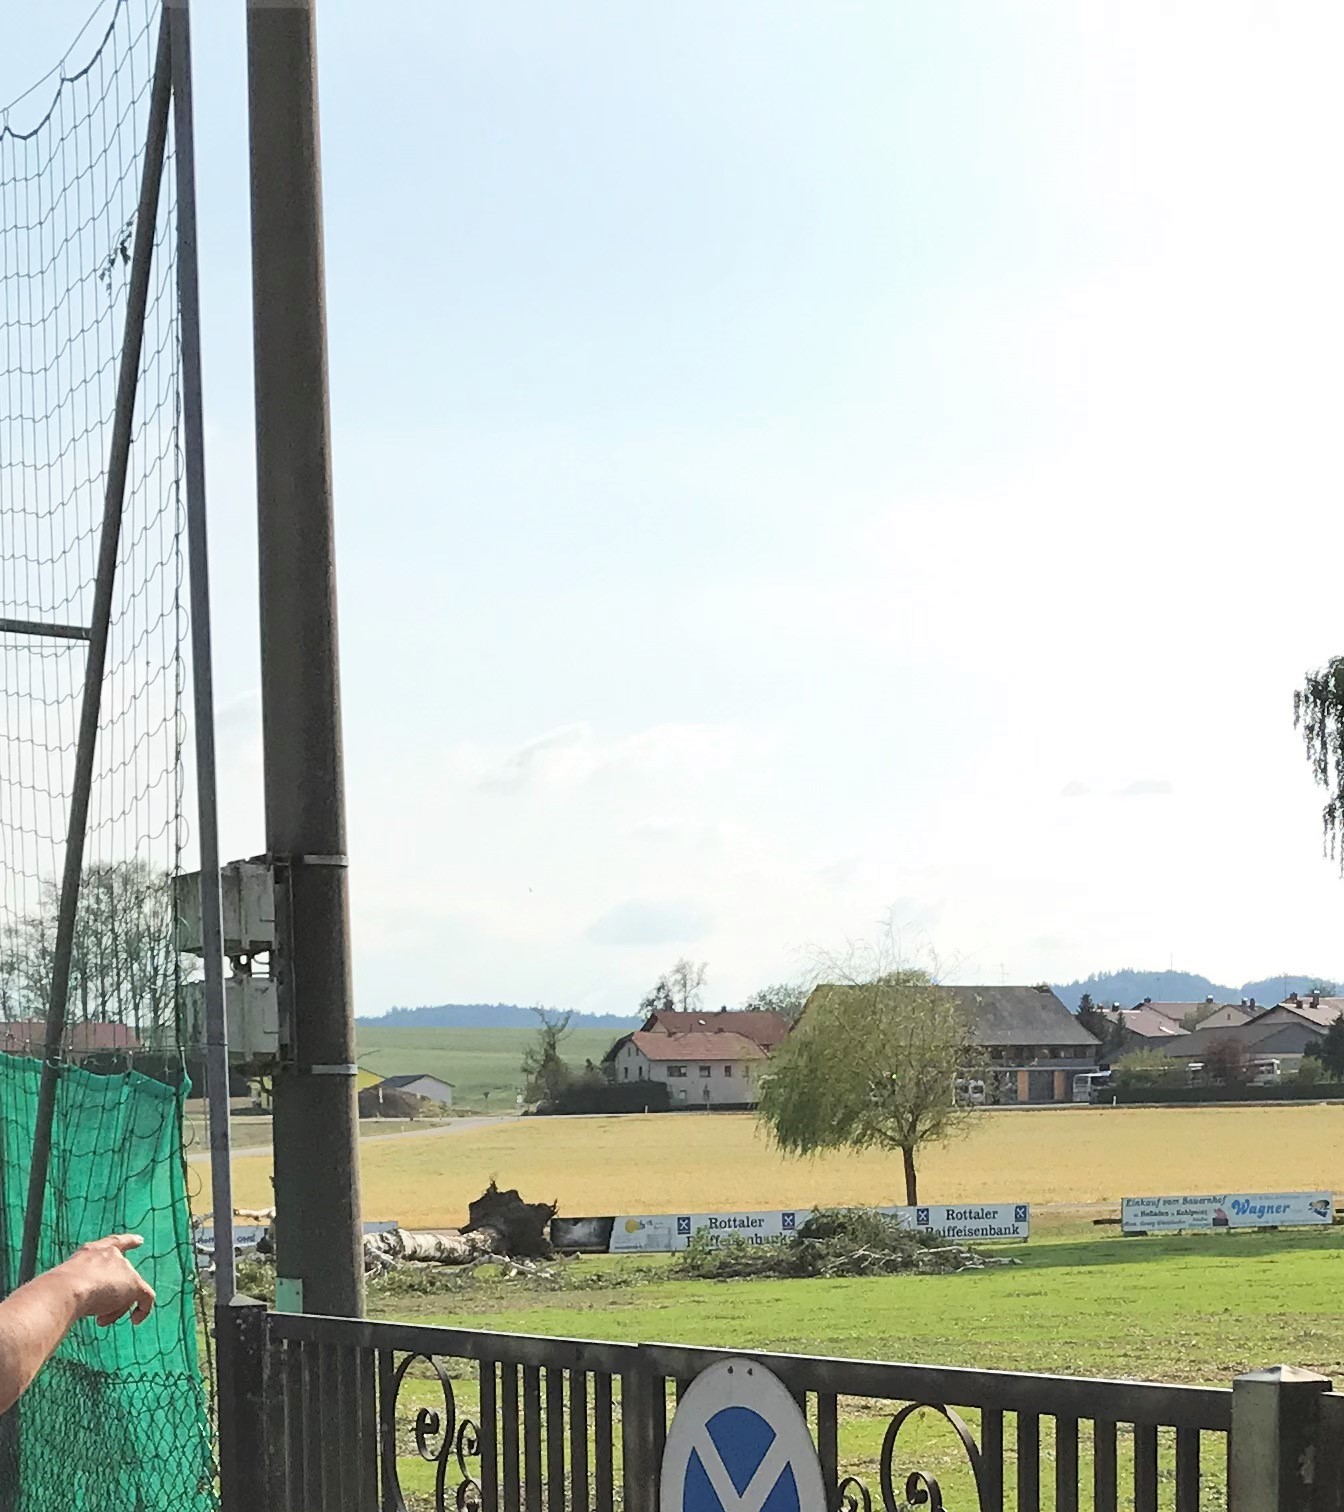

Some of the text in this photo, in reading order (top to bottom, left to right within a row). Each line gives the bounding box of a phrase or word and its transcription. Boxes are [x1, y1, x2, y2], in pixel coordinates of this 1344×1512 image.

[946, 1207, 999, 1221] Rottaler
[1231, 1199, 1291, 1220] Wagner
[708, 1215, 765, 1230] Rottaler
